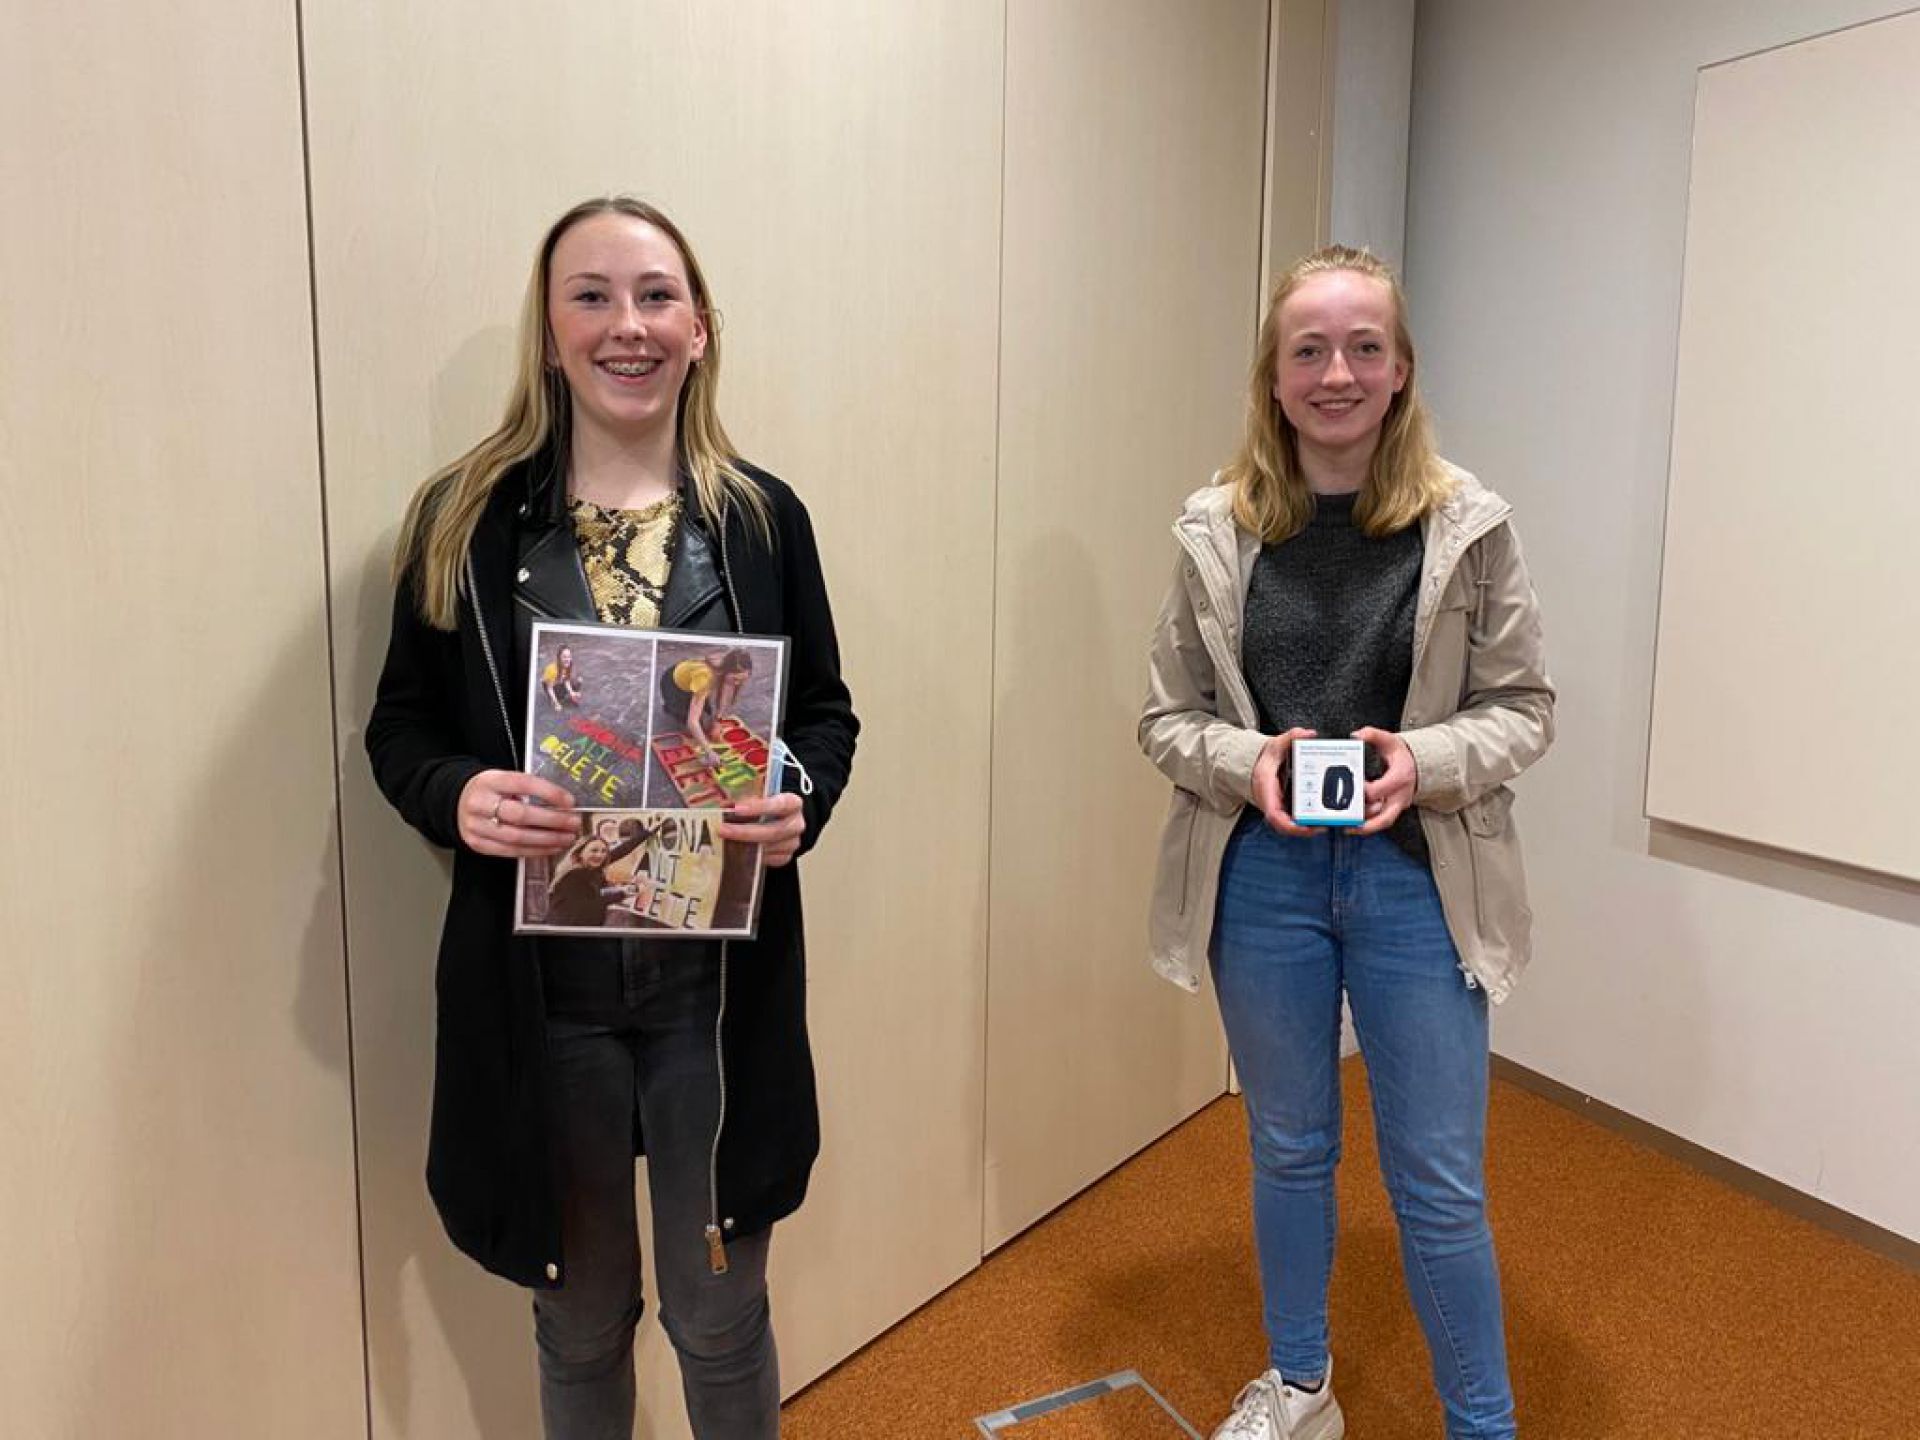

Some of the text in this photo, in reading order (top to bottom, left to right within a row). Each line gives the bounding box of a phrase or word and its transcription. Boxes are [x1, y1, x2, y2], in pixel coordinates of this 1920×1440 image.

[540, 734, 620, 803] DELETE
[633, 851, 681, 884] ALT
[628, 884, 702, 928] LETE
